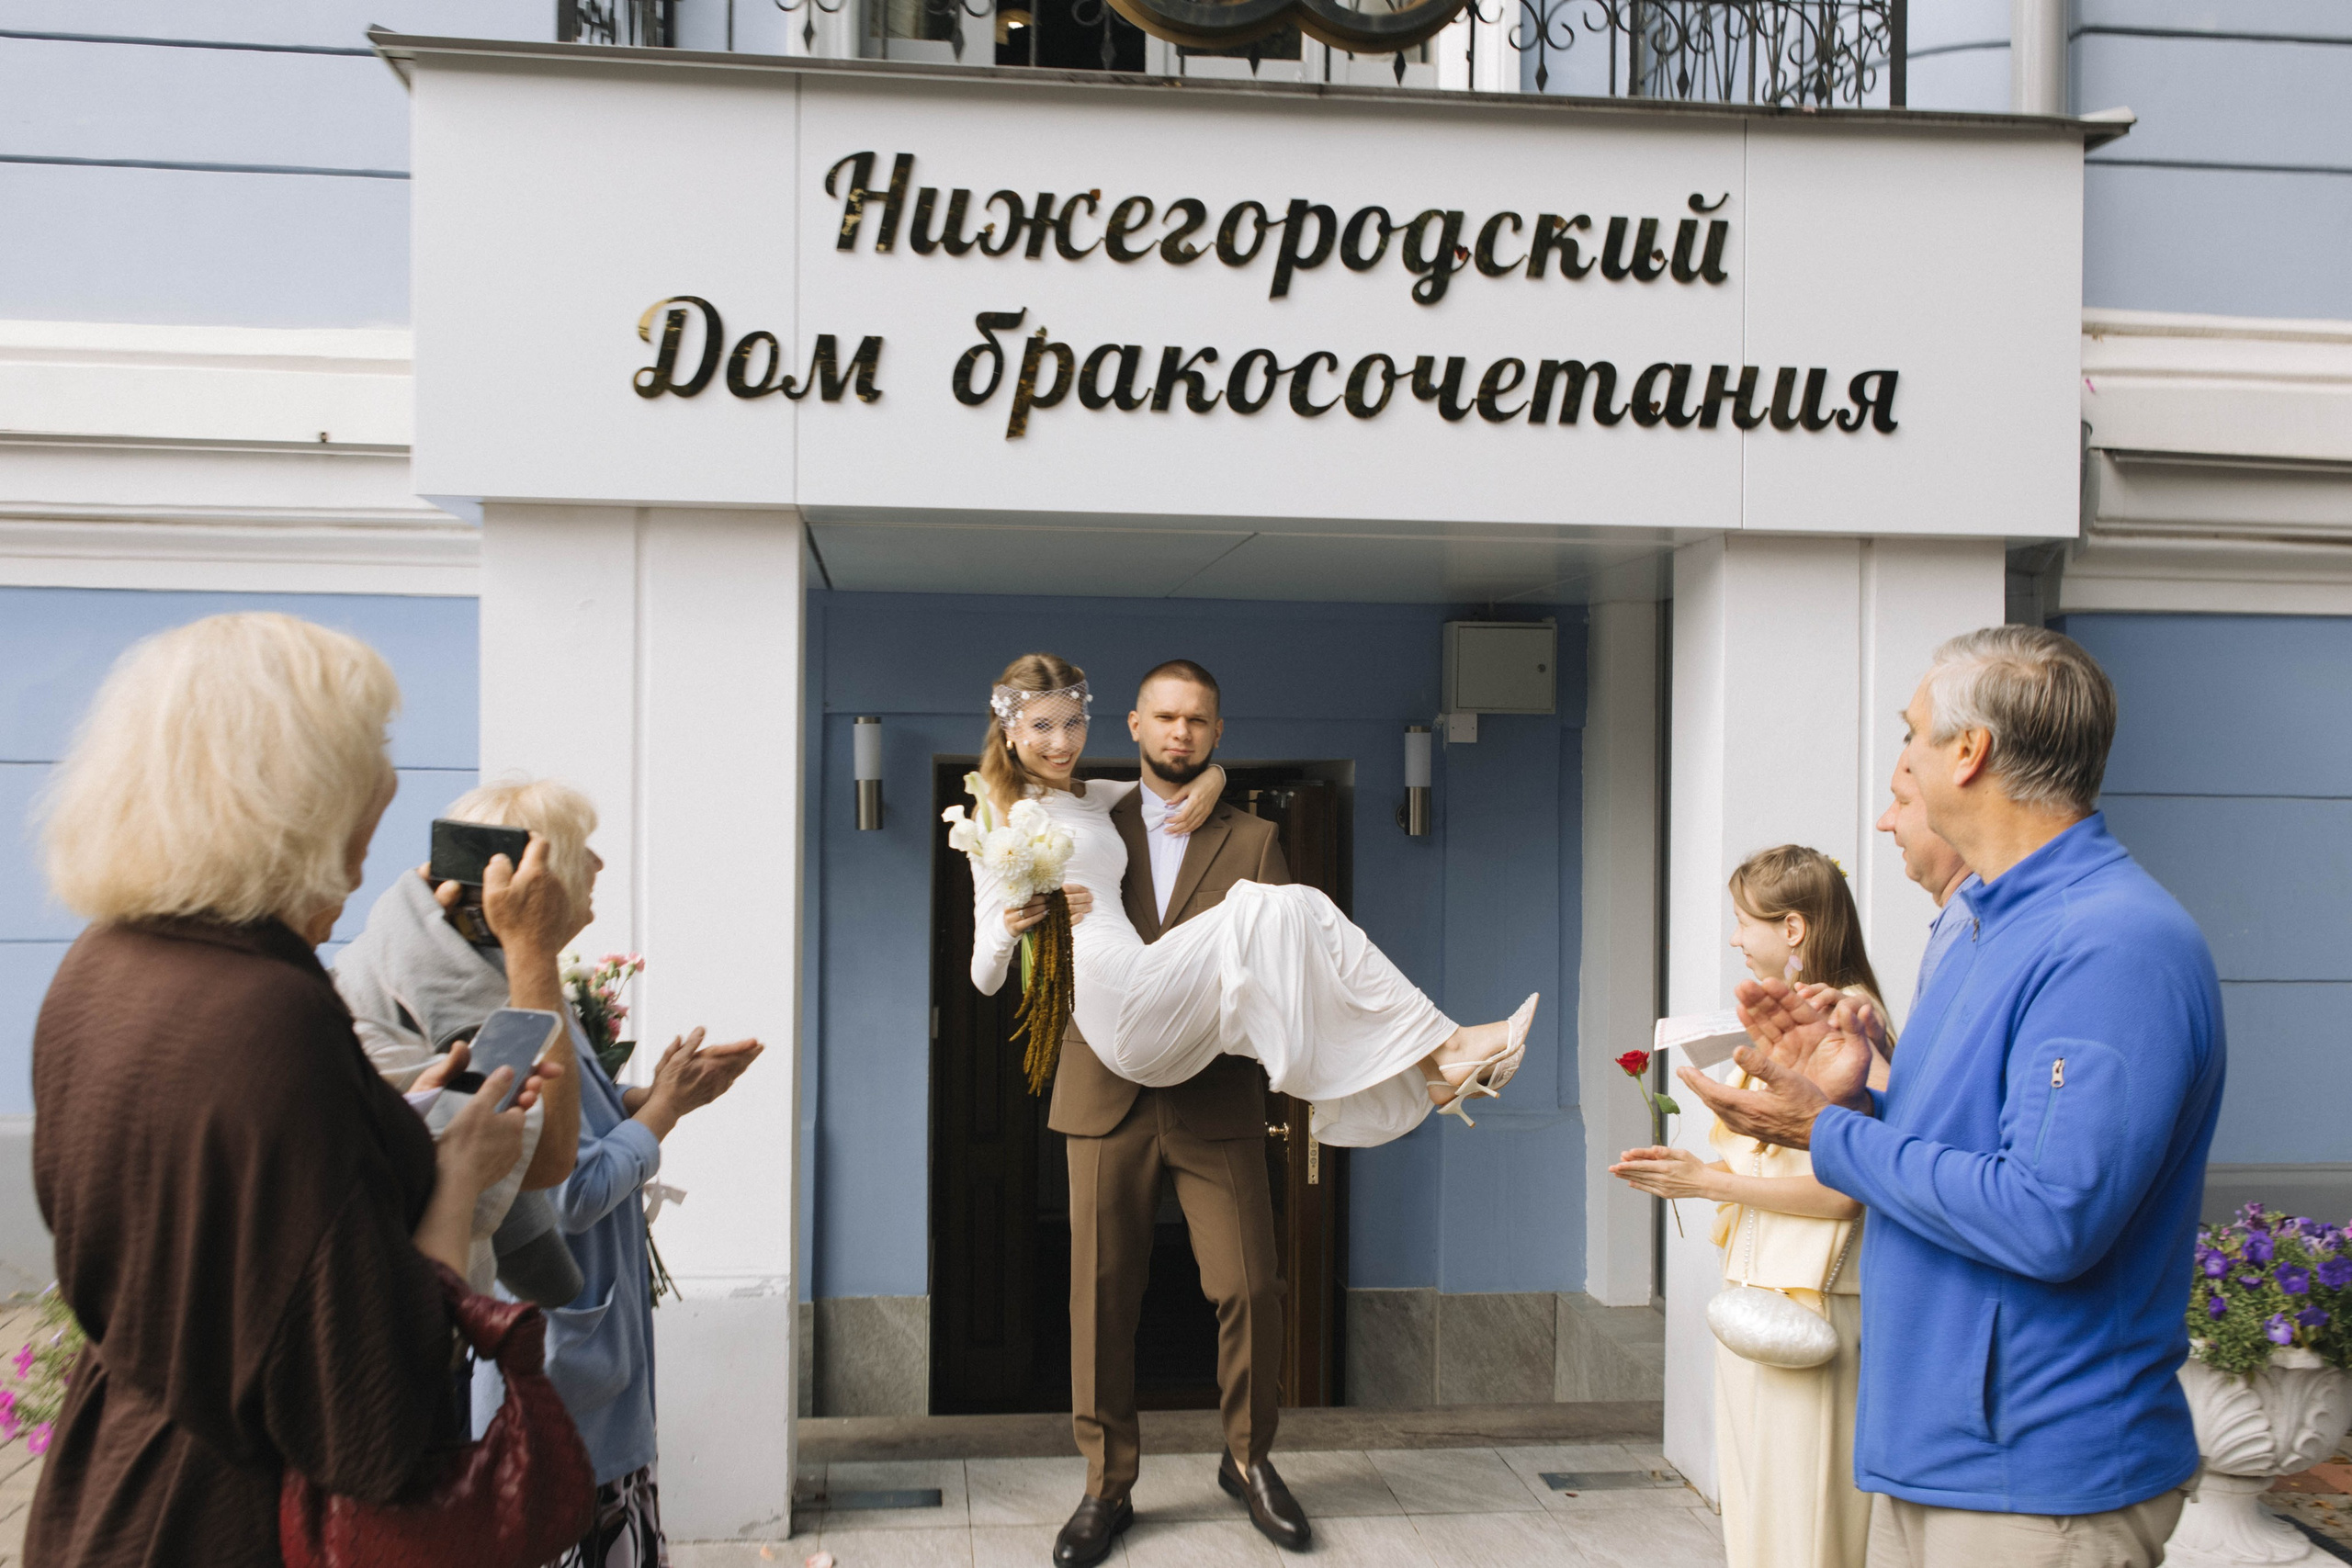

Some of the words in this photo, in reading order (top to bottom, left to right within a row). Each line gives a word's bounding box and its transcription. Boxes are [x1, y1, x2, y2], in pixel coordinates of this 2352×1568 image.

[824, 151, 1730, 306] Нижегородский
[633, 295, 884, 404] Дом
[952, 306, 1900, 439] бракосочетания
